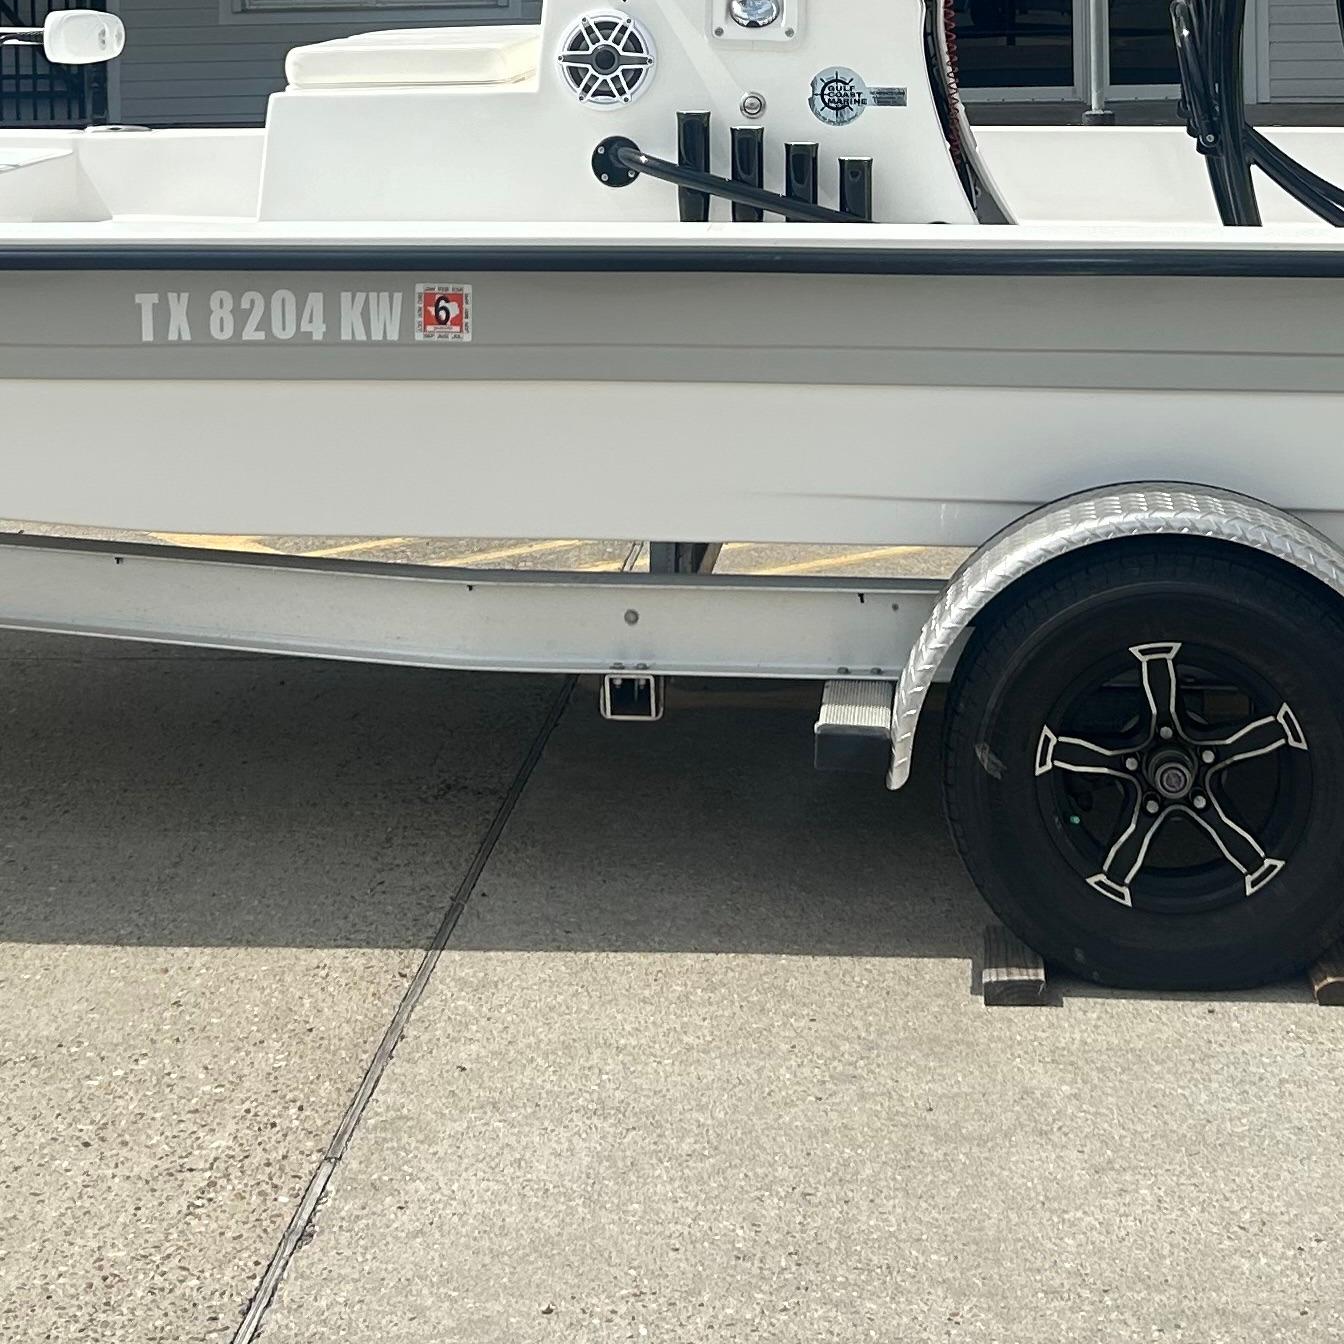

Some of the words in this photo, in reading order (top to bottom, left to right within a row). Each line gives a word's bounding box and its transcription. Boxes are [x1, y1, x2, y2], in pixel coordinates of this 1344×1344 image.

[827, 97, 868, 106] MARINE
[135, 291, 192, 342] TX
[209, 289, 327, 341] 8204
[340, 291, 404, 341] KW
[434, 295, 451, 325] 6
